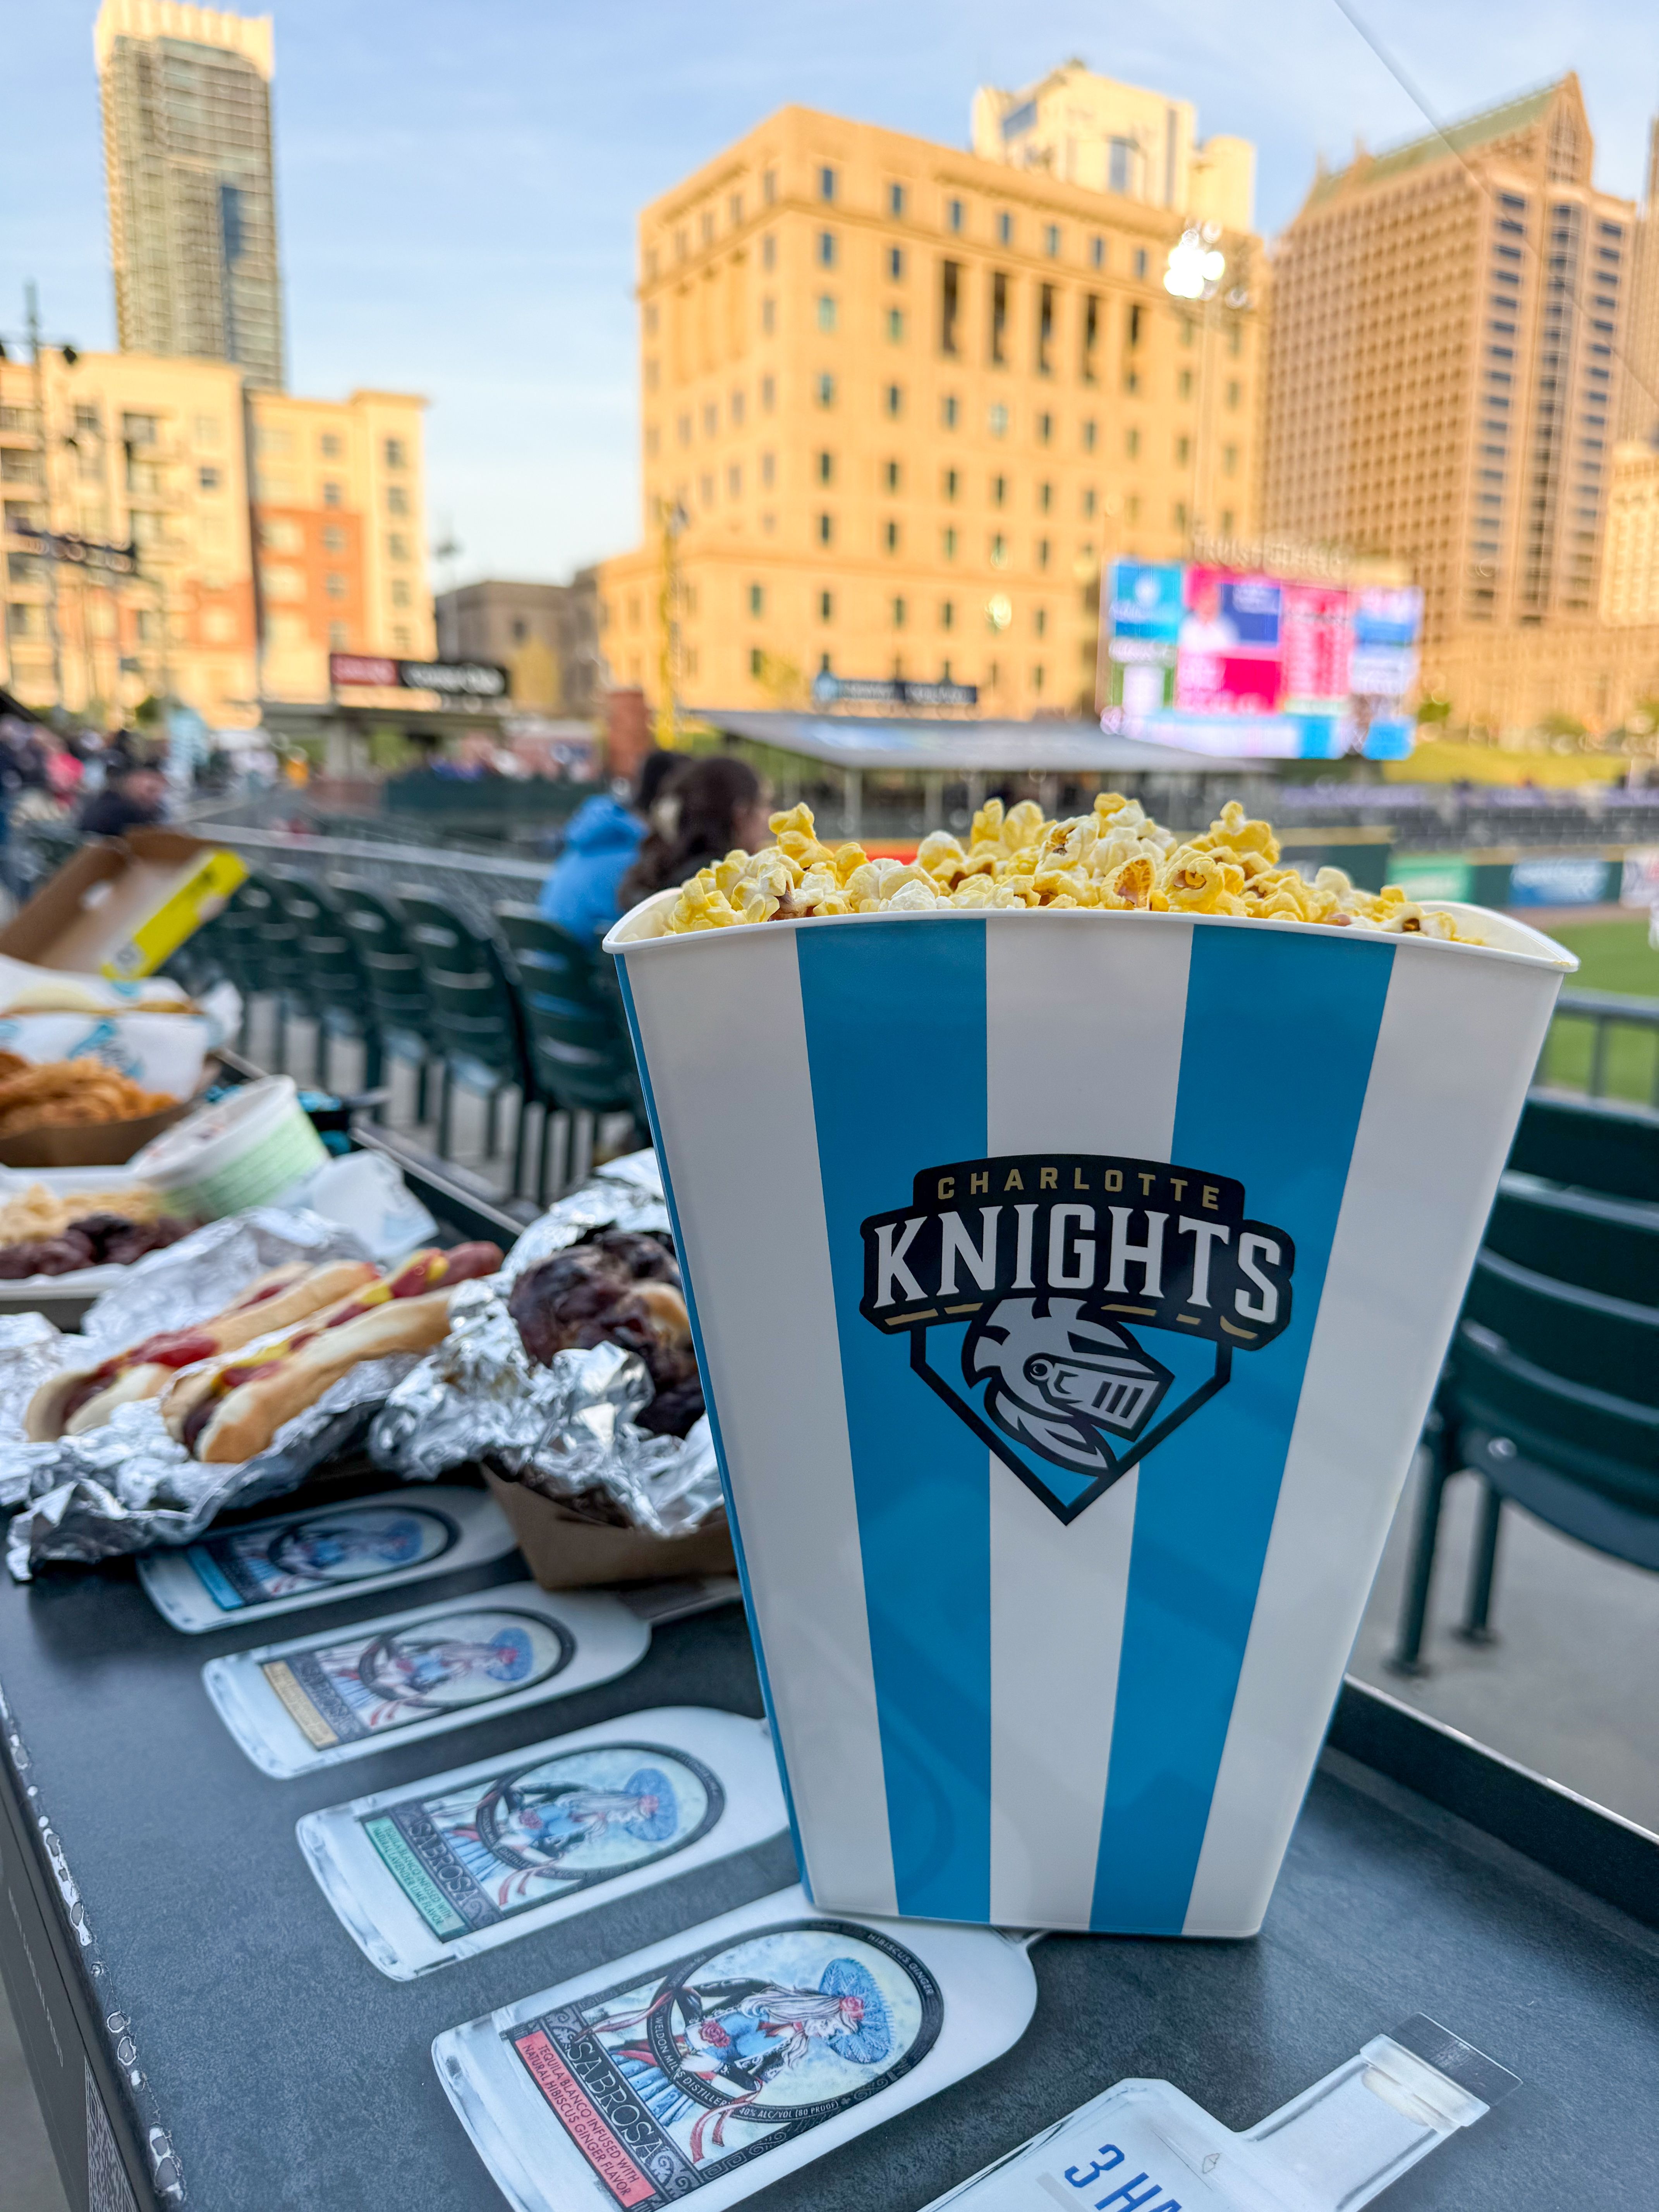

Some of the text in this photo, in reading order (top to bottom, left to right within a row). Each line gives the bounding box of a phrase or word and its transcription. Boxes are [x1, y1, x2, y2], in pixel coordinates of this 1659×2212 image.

[938, 1167, 1220, 1211] CHARLOTTE
[873, 1203, 1282, 1323] KNIGHTS
[408, 1821, 478, 1906] SABROSA
[436, 1902, 453, 1918] WITH
[867, 1933, 934, 1995] HIBISCUS GINGER
[565, 2041, 662, 2164] SABROSA
[654, 2016, 670, 2053] WELDON
[683, 2076, 730, 2107] DISTILLER
[522, 2044, 632, 2196] NATURAL HIBISCUS GINGER FLAVOR
[538, 2044, 639, 2183] TEQUILA BLANCO INFUSED WITH
[757, 2108, 792, 2119] ALC/VOL
[795, 2109, 808, 2118] (80
[811, 2100, 839, 2114] PROOF)
[1064, 2144, 1125, 2188] 3
